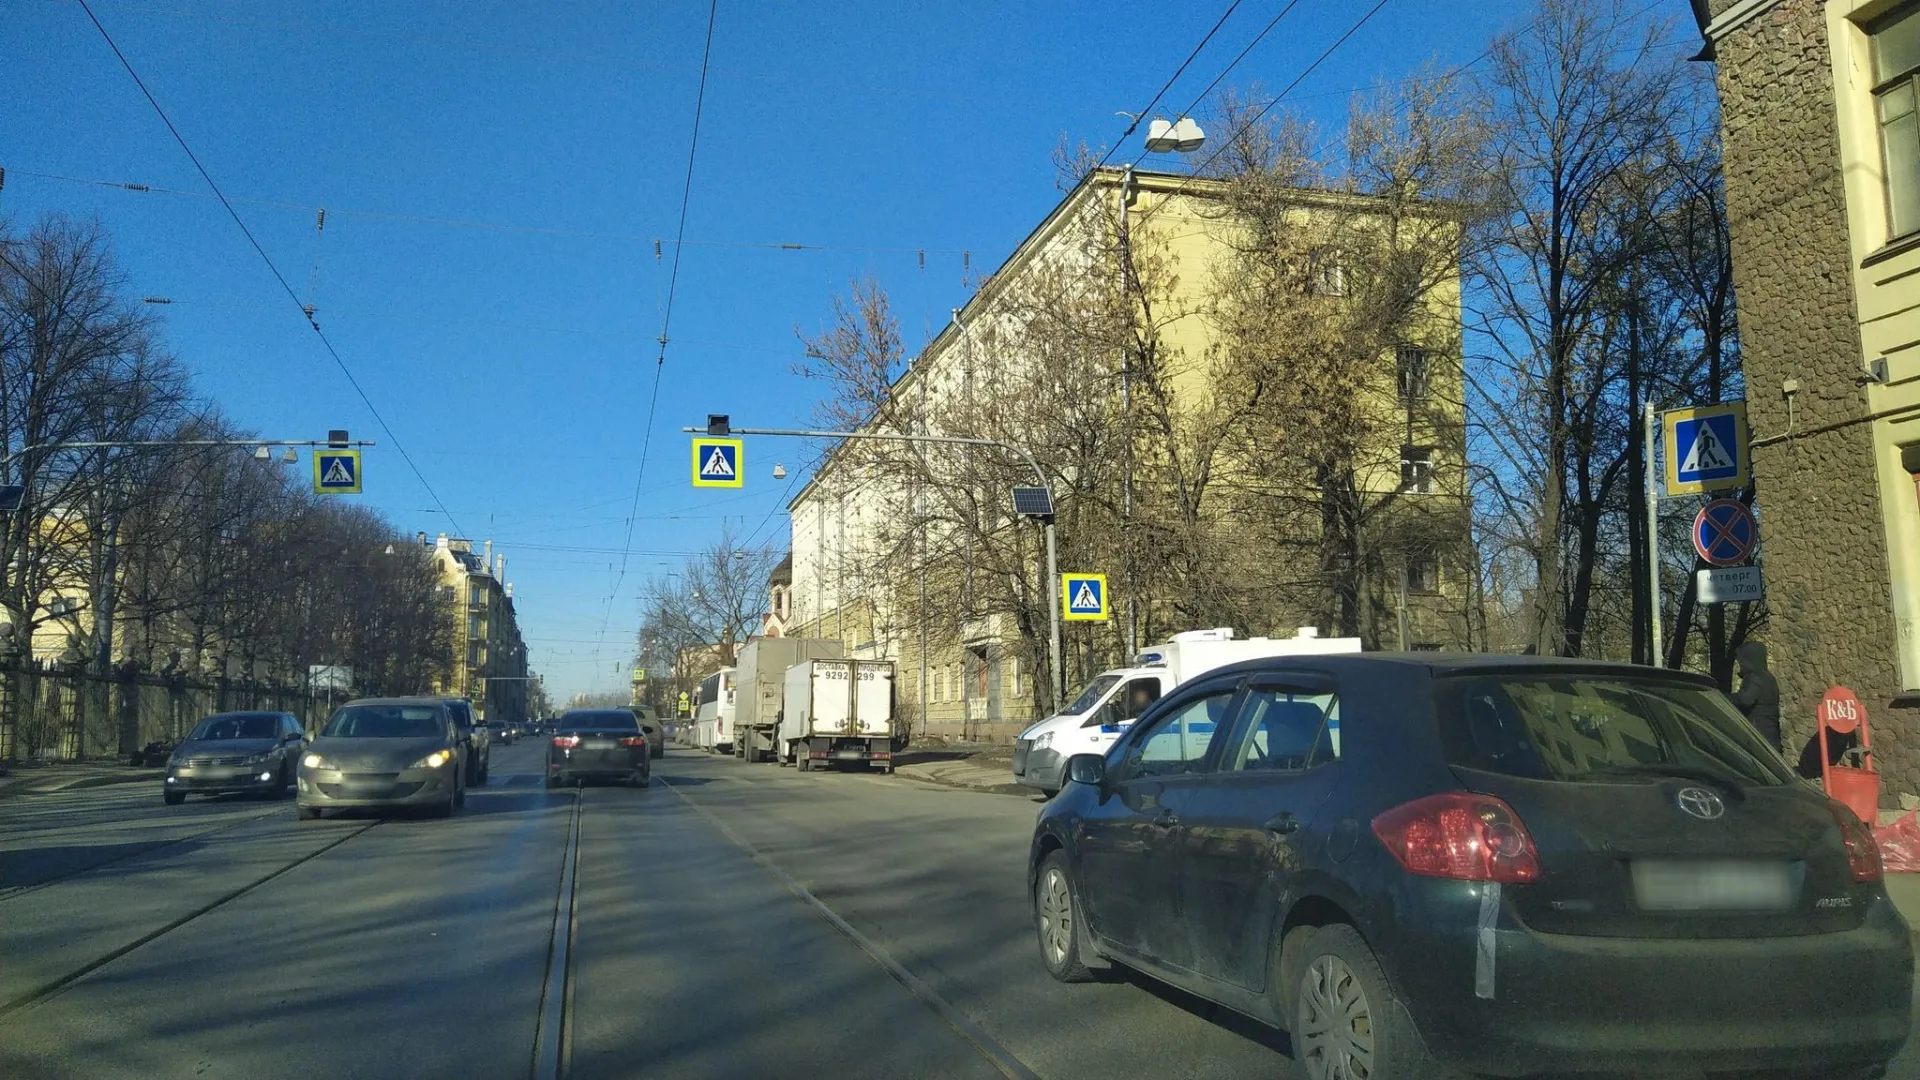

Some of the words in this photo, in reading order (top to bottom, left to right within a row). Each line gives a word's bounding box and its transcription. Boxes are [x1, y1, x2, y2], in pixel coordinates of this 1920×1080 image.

[816, 663, 846, 671] ДОСТАВКА
[858, 664, 891, 673] ПРОДУКТОВ
[825, 671, 849, 680] 9292
[858, 672, 875, 681] 299
[1826, 699, 1857, 721] К&Б
[1815, 897, 1852, 908] AURIS
